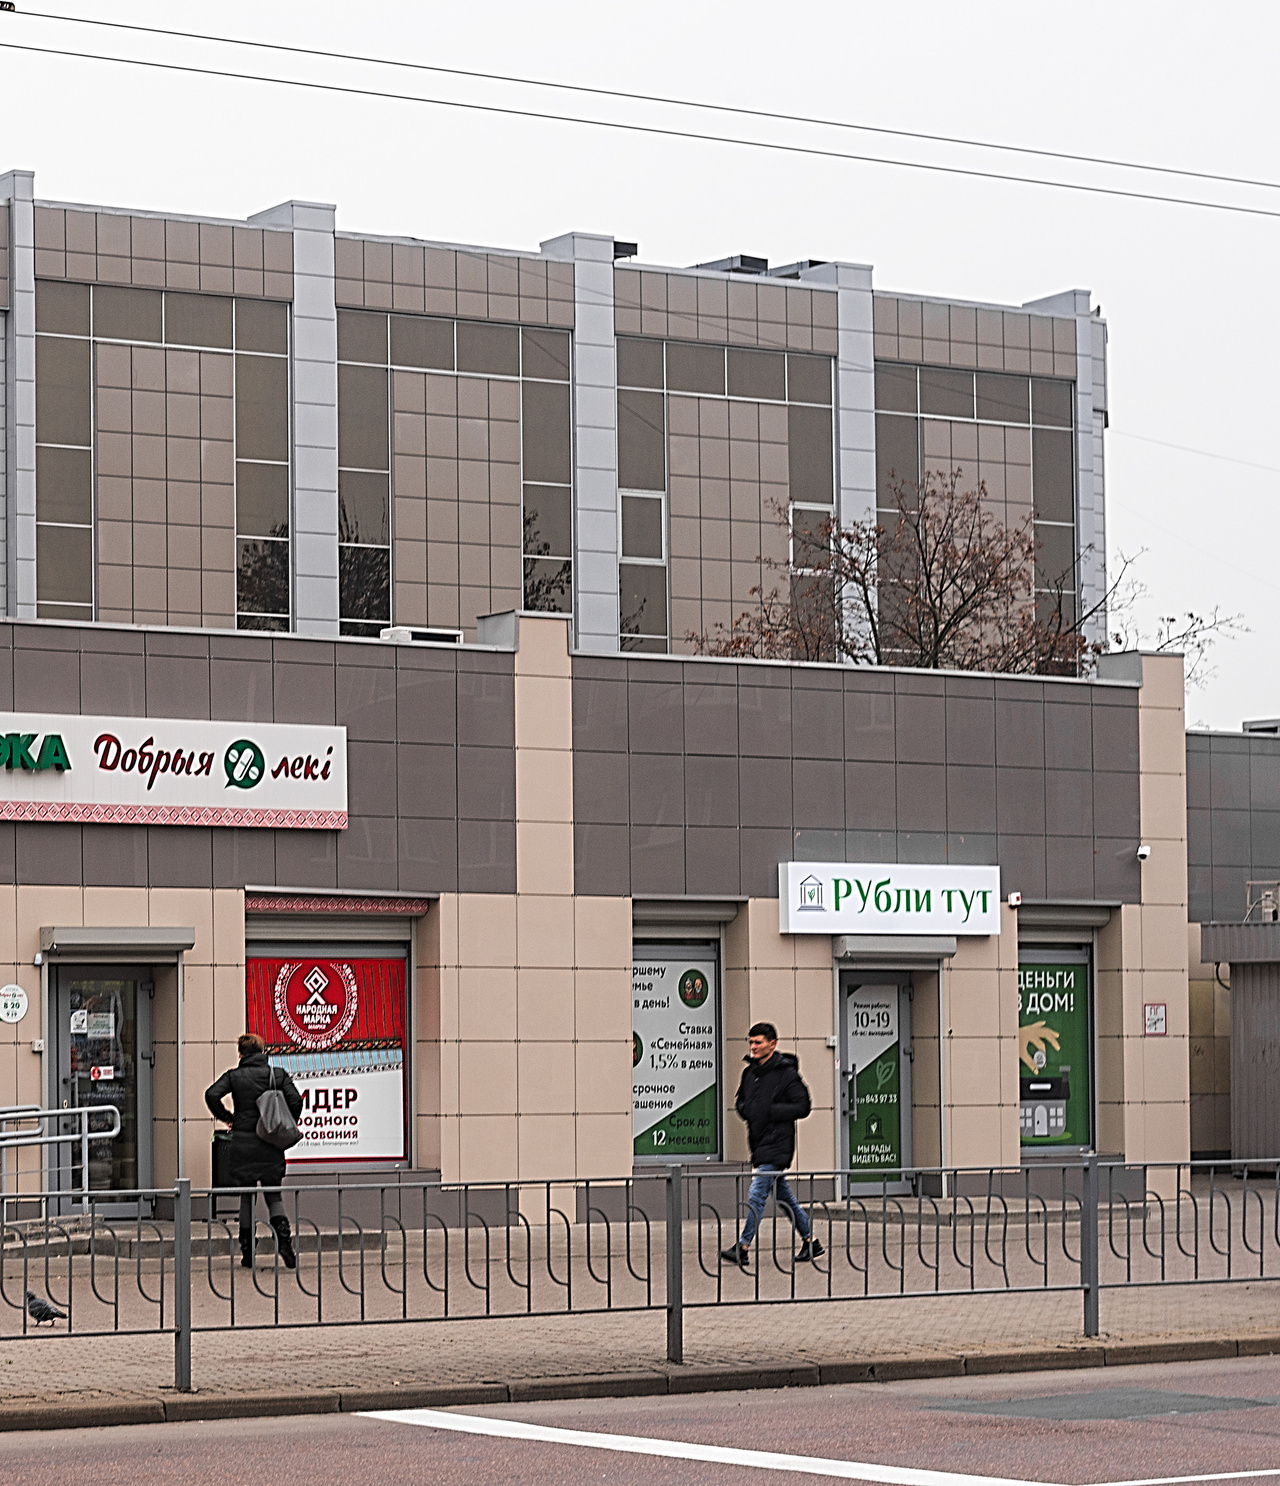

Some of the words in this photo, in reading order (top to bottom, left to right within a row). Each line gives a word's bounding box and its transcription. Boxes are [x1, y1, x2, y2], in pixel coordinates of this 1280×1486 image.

[93, 733, 215, 791] Добрыя
[271, 746, 334, 780] лекі
[941, 889, 992, 923] тут
[632, 981, 654, 991] мье
[296, 1004, 337, 1015] НАРОДНАЯ
[642, 996, 670, 1010] день!
[1026, 993, 1074, 1015] ДОМ!
[303, 1014, 331, 1024] МАРКА
[855, 1011, 890, 1028] 10-19
[679, 1022, 713, 1035] Ставка
[650, 1037, 713, 1050] «Семейная»
[650, 1054, 678, 1071] 1,5%
[681, 1060, 687, 1069] в
[689, 1060, 713, 1070] день
[633, 1084, 675, 1096] срочное
[633, 1100, 674, 1109] ашение
[669, 1115, 695, 1130] Срок
[697, 1119, 710, 1129] до
[652, 1129, 666, 1146] 12
[668, 1136, 710, 1146] месяцев
[857, 1145, 869, 1153] МЫ
[871, 1144, 891, 1154] РАДЫ
[852, 1154, 879, 1164] ВИДЕТЬ
[880, 1153, 897, 1163] ВАС!
